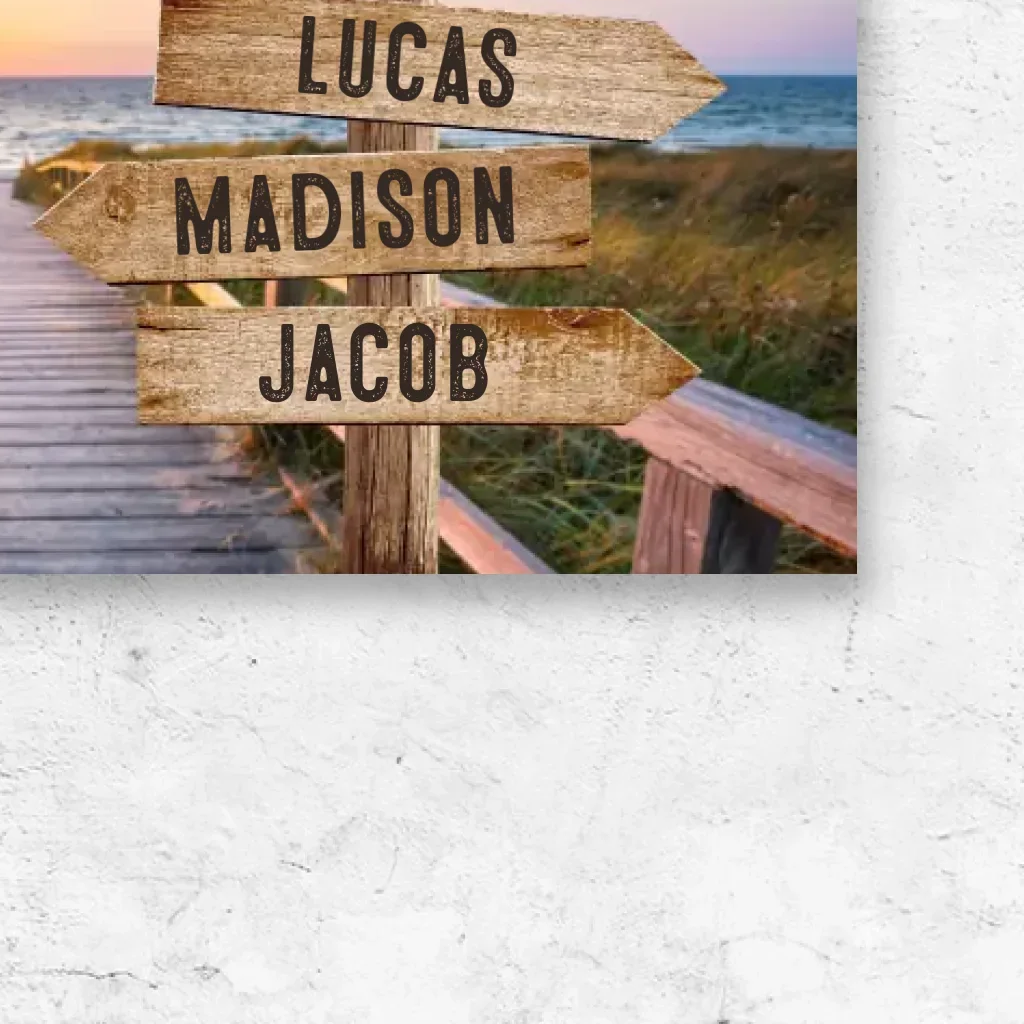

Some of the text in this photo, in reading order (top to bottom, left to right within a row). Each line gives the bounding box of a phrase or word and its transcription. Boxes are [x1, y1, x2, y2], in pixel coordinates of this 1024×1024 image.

[298, 15, 517, 108] LUCAS
[175, 166, 515, 255] MADISON
[259, 322, 489, 402] JACOB
